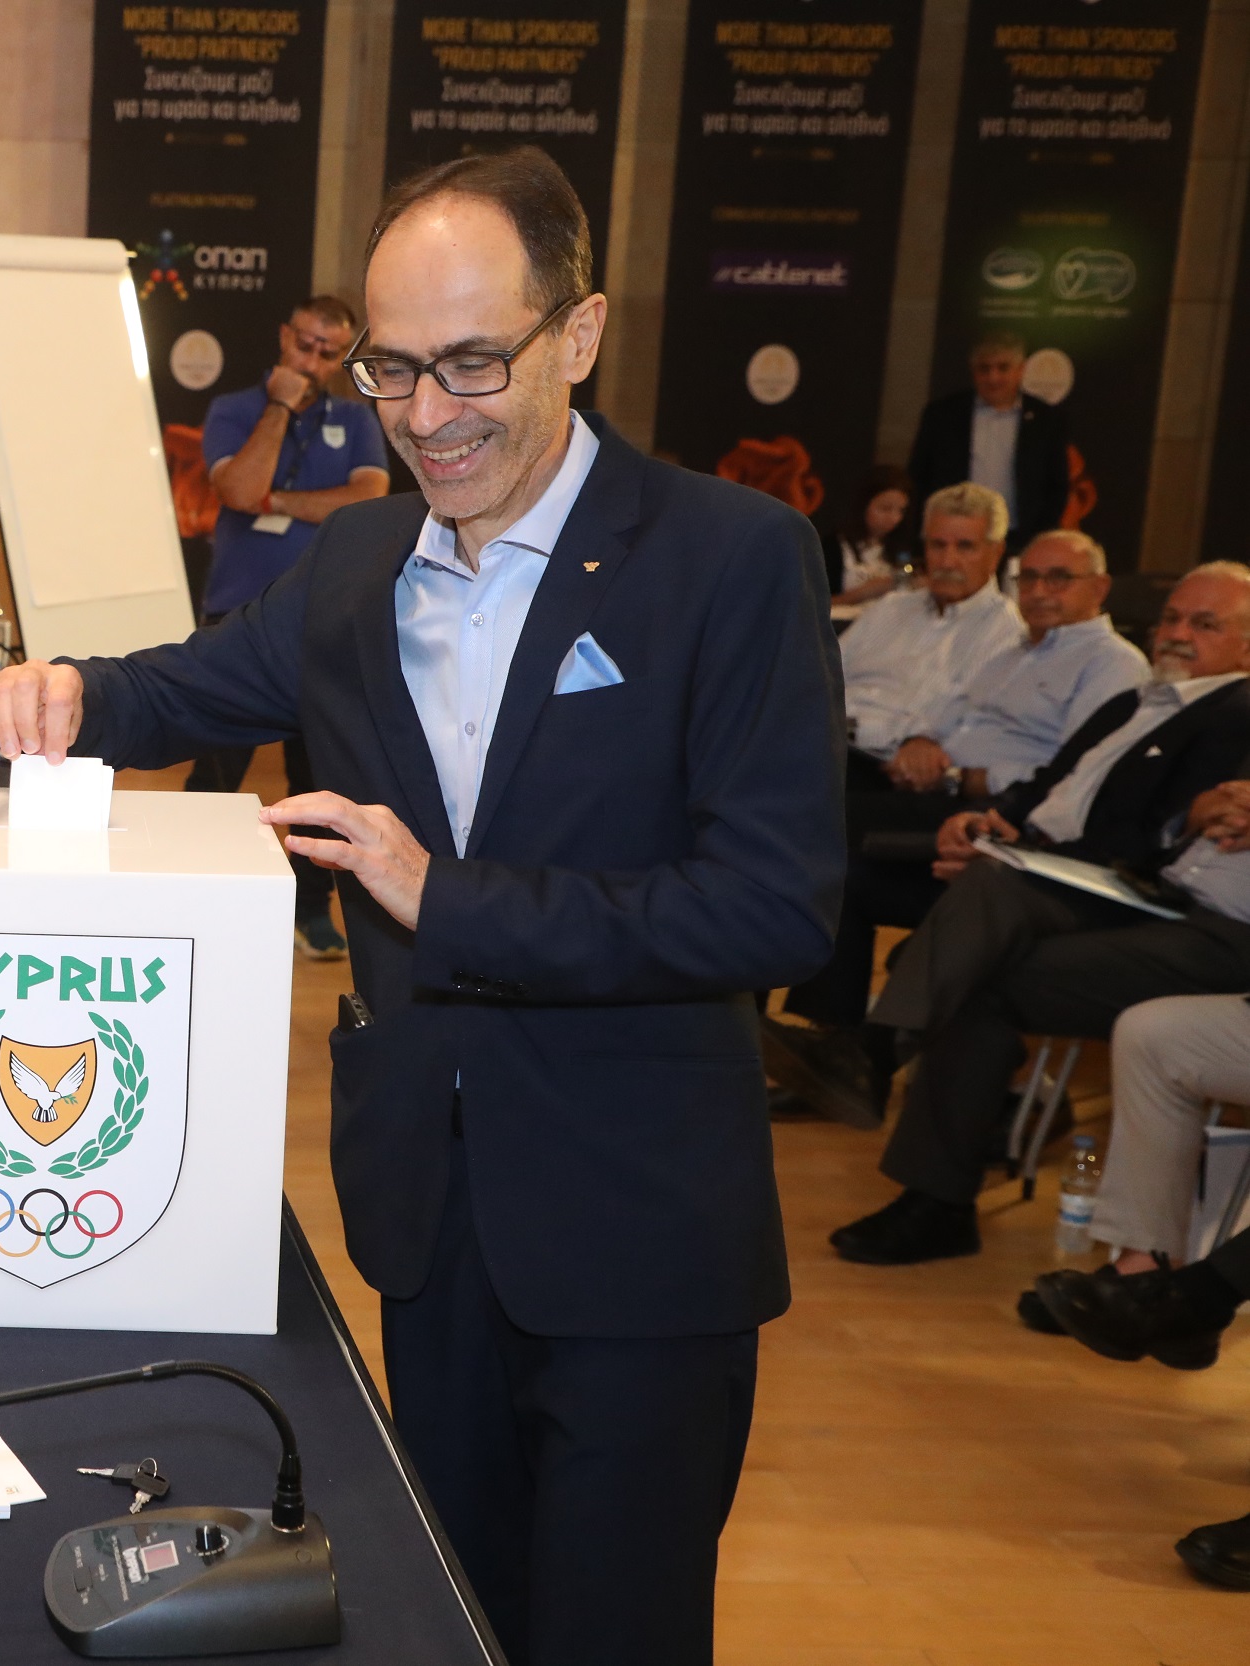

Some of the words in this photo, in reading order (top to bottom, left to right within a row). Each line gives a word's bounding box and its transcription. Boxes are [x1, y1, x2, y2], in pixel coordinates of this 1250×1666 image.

[122, 7, 167, 31] MORE
[172, 7, 215, 31] THAN
[217, 8, 300, 35] SPONSORS
[422, 17, 466, 42] MORE
[472, 18, 513, 42] THAN
[516, 19, 600, 47] SPONSORS
